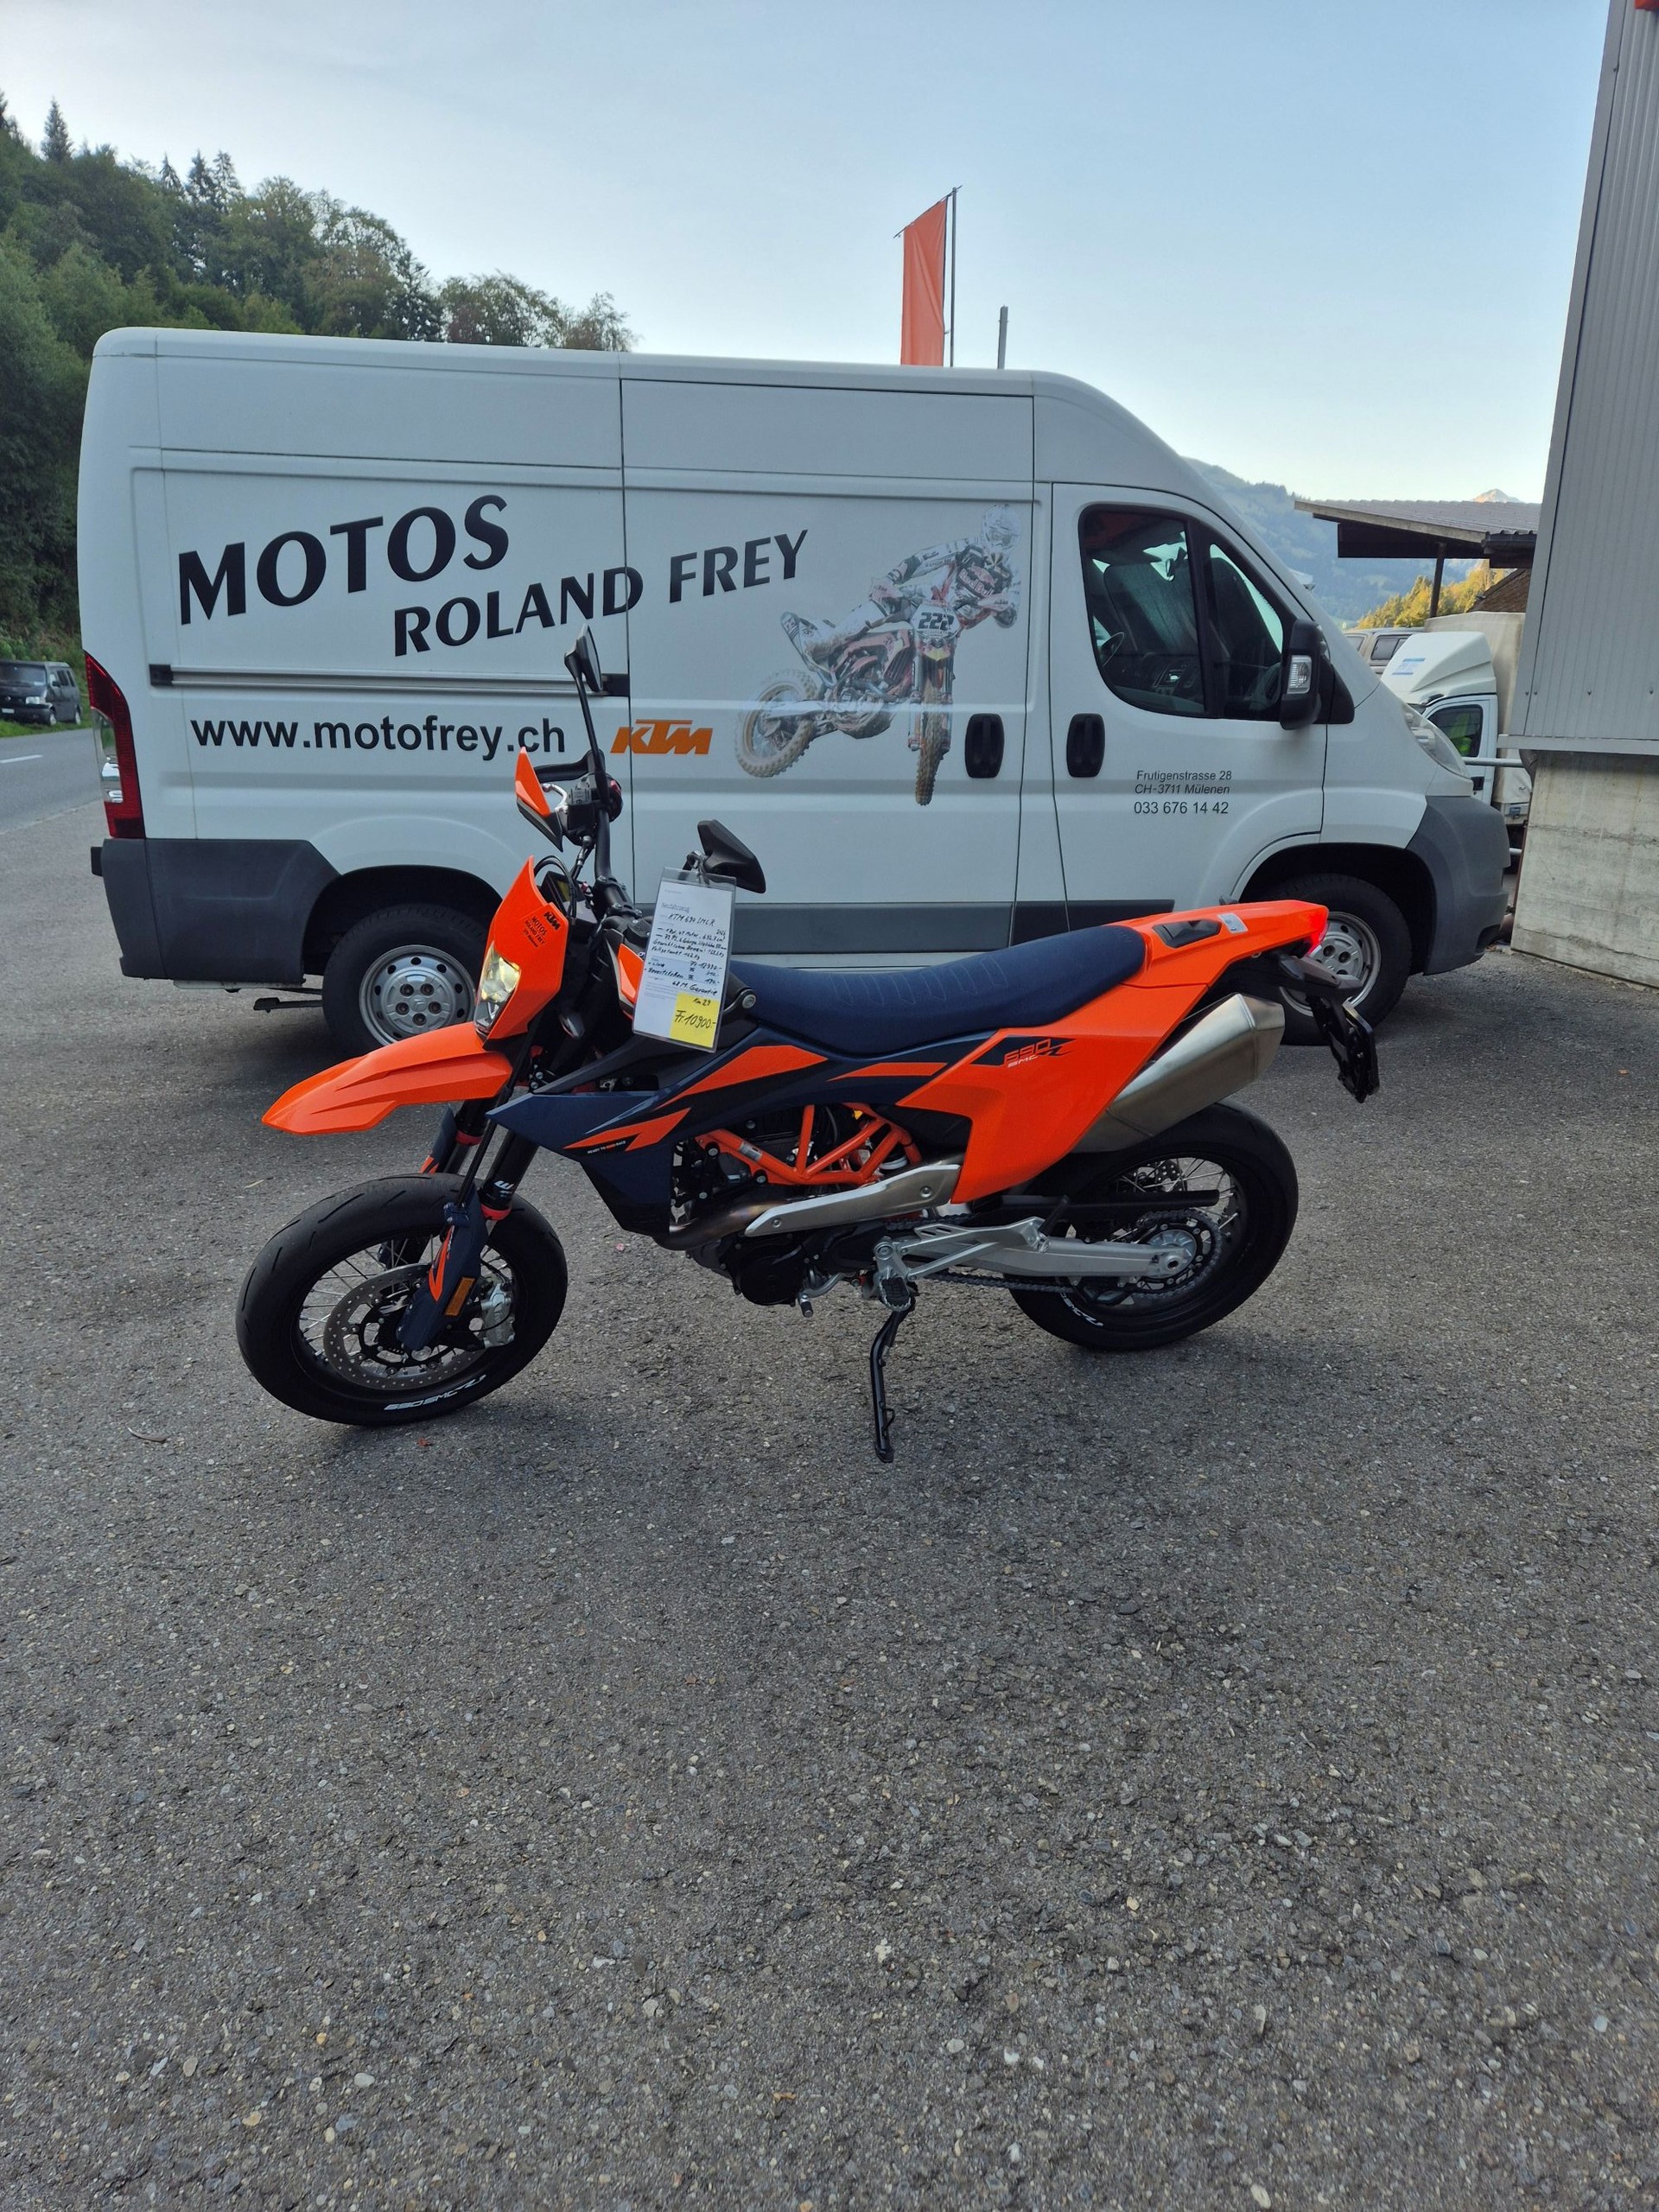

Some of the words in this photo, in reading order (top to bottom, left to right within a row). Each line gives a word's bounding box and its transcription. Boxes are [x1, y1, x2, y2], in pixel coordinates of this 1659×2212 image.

[178, 494, 509, 626] MOTOS
[394, 566, 644, 658] ROLAND
[669, 529, 808, 604] FREY
[918, 612, 955, 632] 222
[190, 715, 565, 761] www.motofrey.ch
[609, 719, 714, 754] KTM
[1136, 770, 1217, 783] Frutigenstrasse
[1218, 770, 1232, 781] 28
[1135, 784, 1180, 794] CH-3711
[1184, 784, 1230, 794] Mülenen
[1134, 801, 1159, 814] 033
[1163, 801, 1187, 814] 676
[1192, 801, 1208, 814] 14
[1211, 801, 1229, 814] 42
[543, 911, 562, 931] KTM
